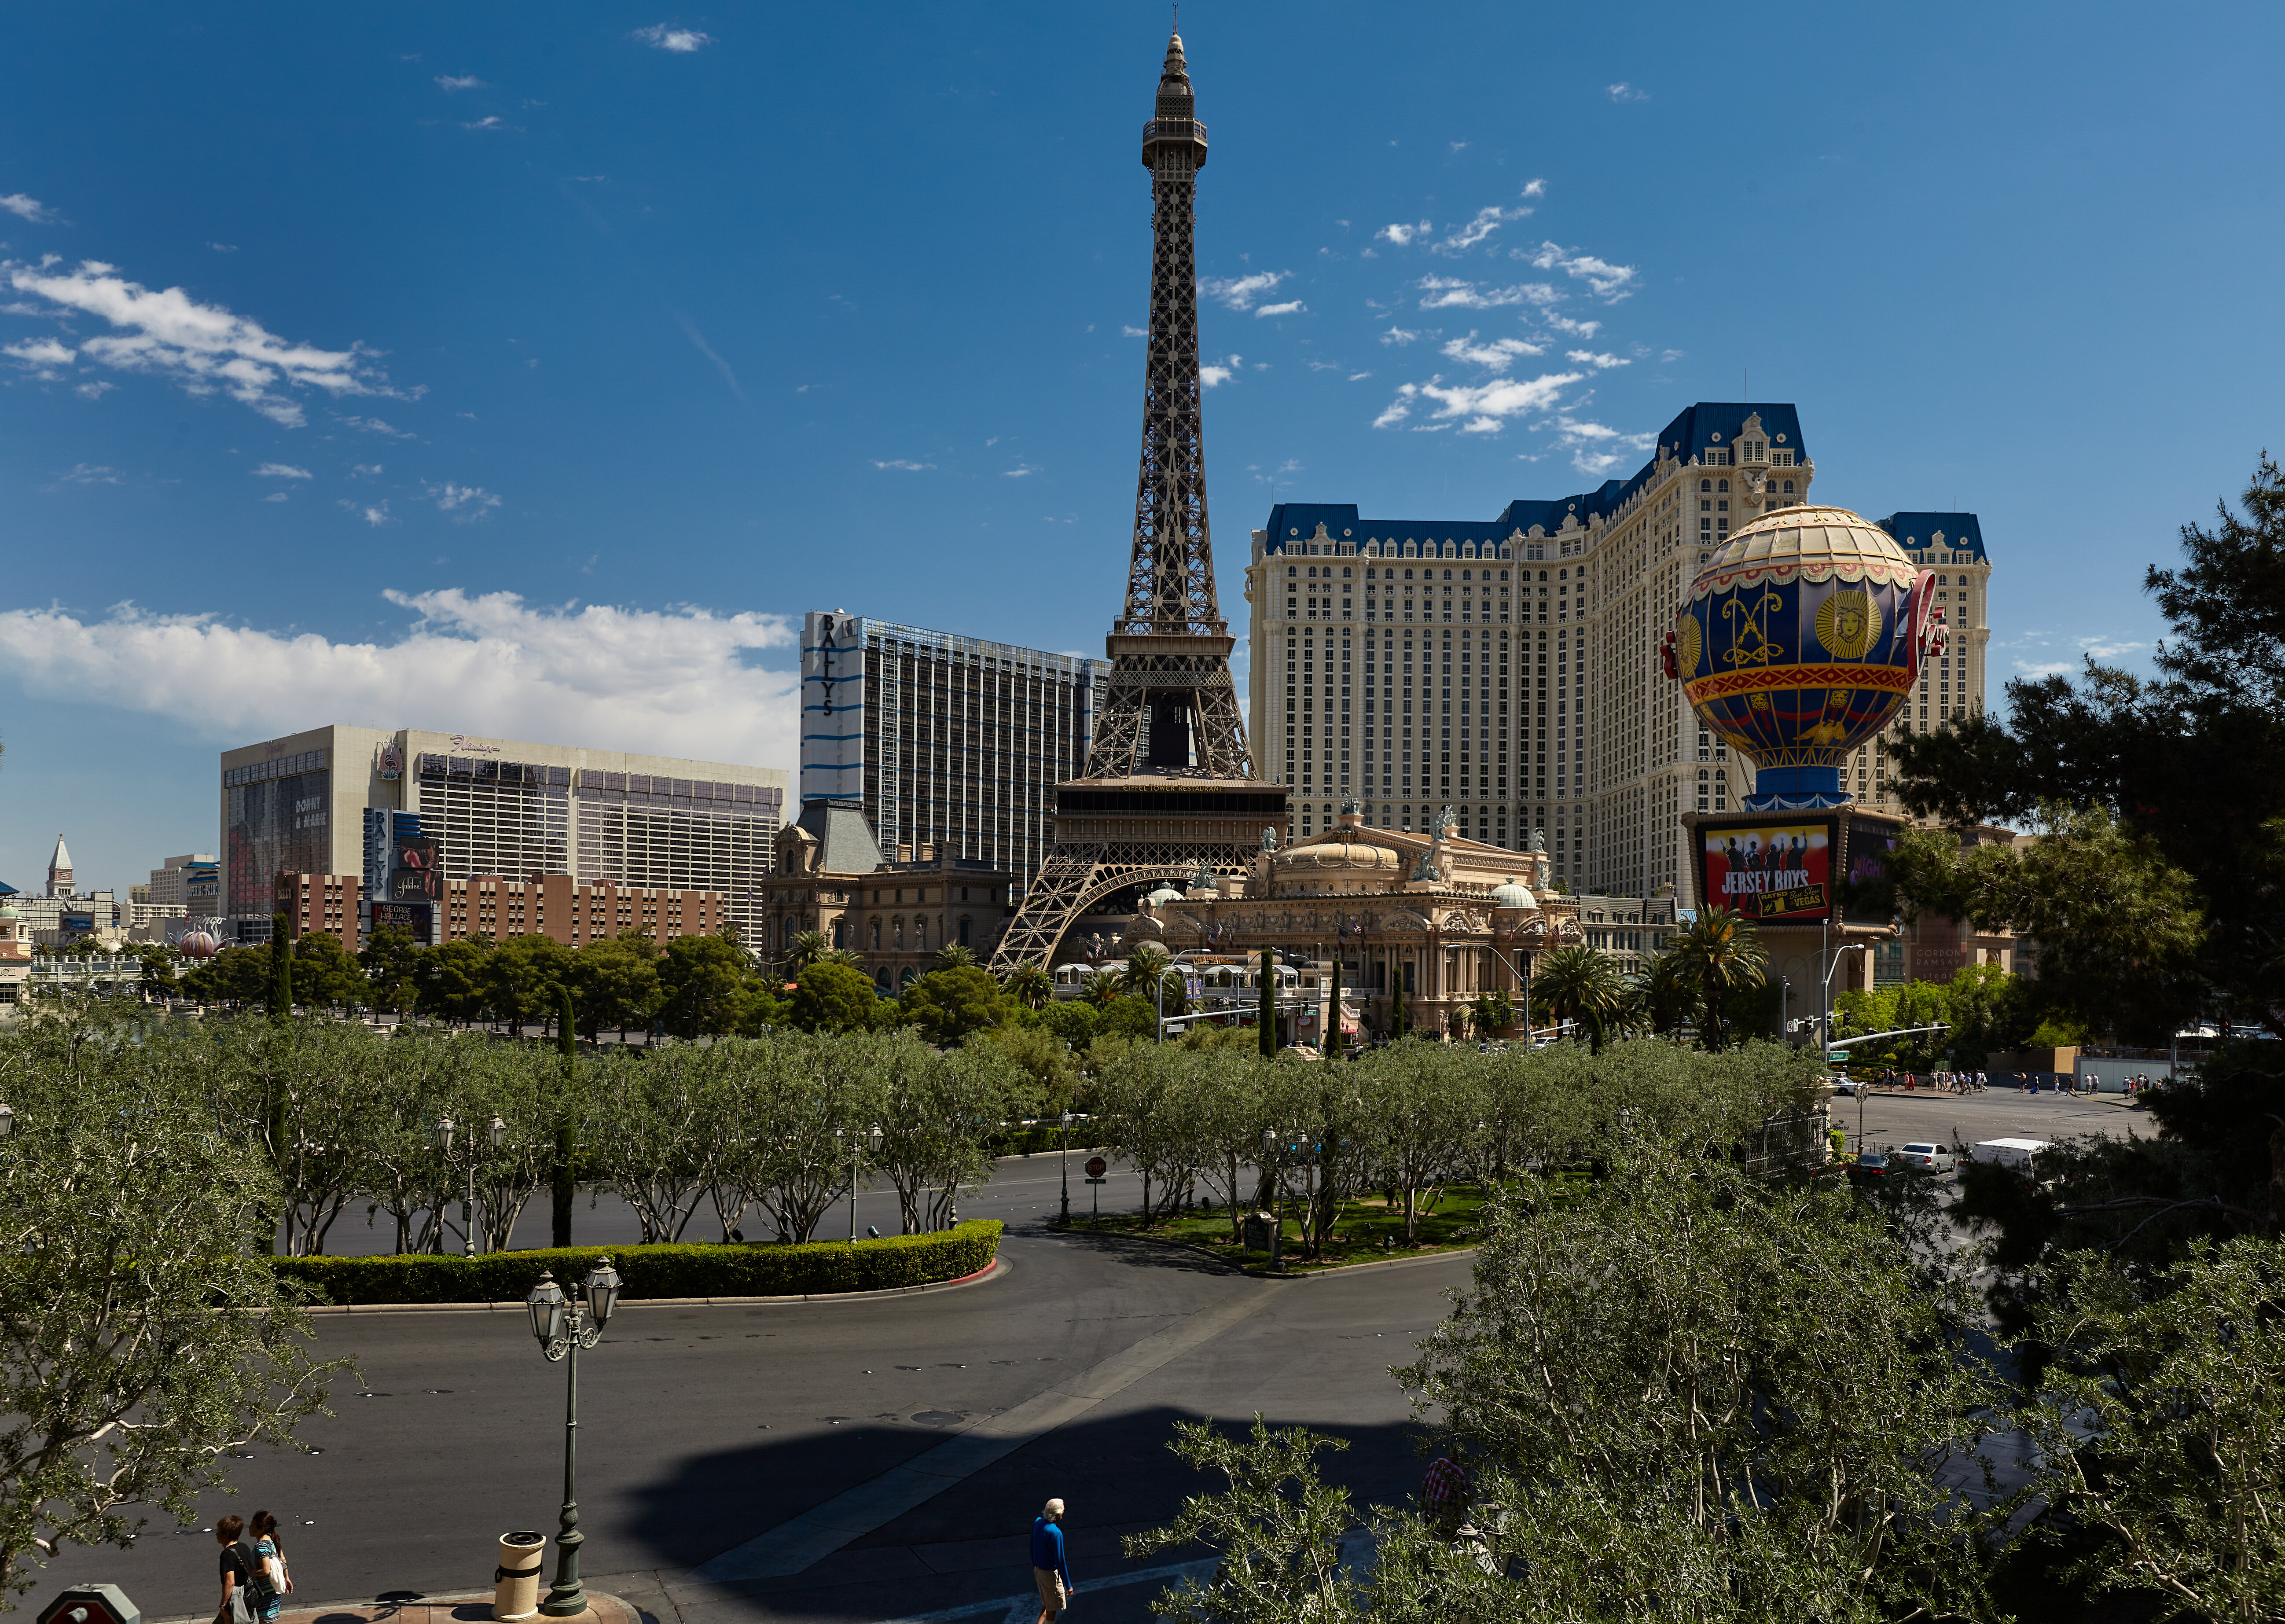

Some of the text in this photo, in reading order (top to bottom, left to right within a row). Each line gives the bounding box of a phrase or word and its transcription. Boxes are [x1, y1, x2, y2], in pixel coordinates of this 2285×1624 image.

[450, 735, 500, 757] Flamingo
[296, 796, 320, 813] DONNY
[296, 812, 327, 829] & MARIE
[395, 877, 421, 898] Jubilee!
[1722, 869, 1809, 894] JERSEY BOYS
[1761, 891, 1788, 900] RATED
[1789, 887, 1820, 899] Best Show
[1794, 895, 1821, 907] VEGAS
[380, 912, 411, 920] WALLACE
[383, 905, 411, 914] GEORGE
